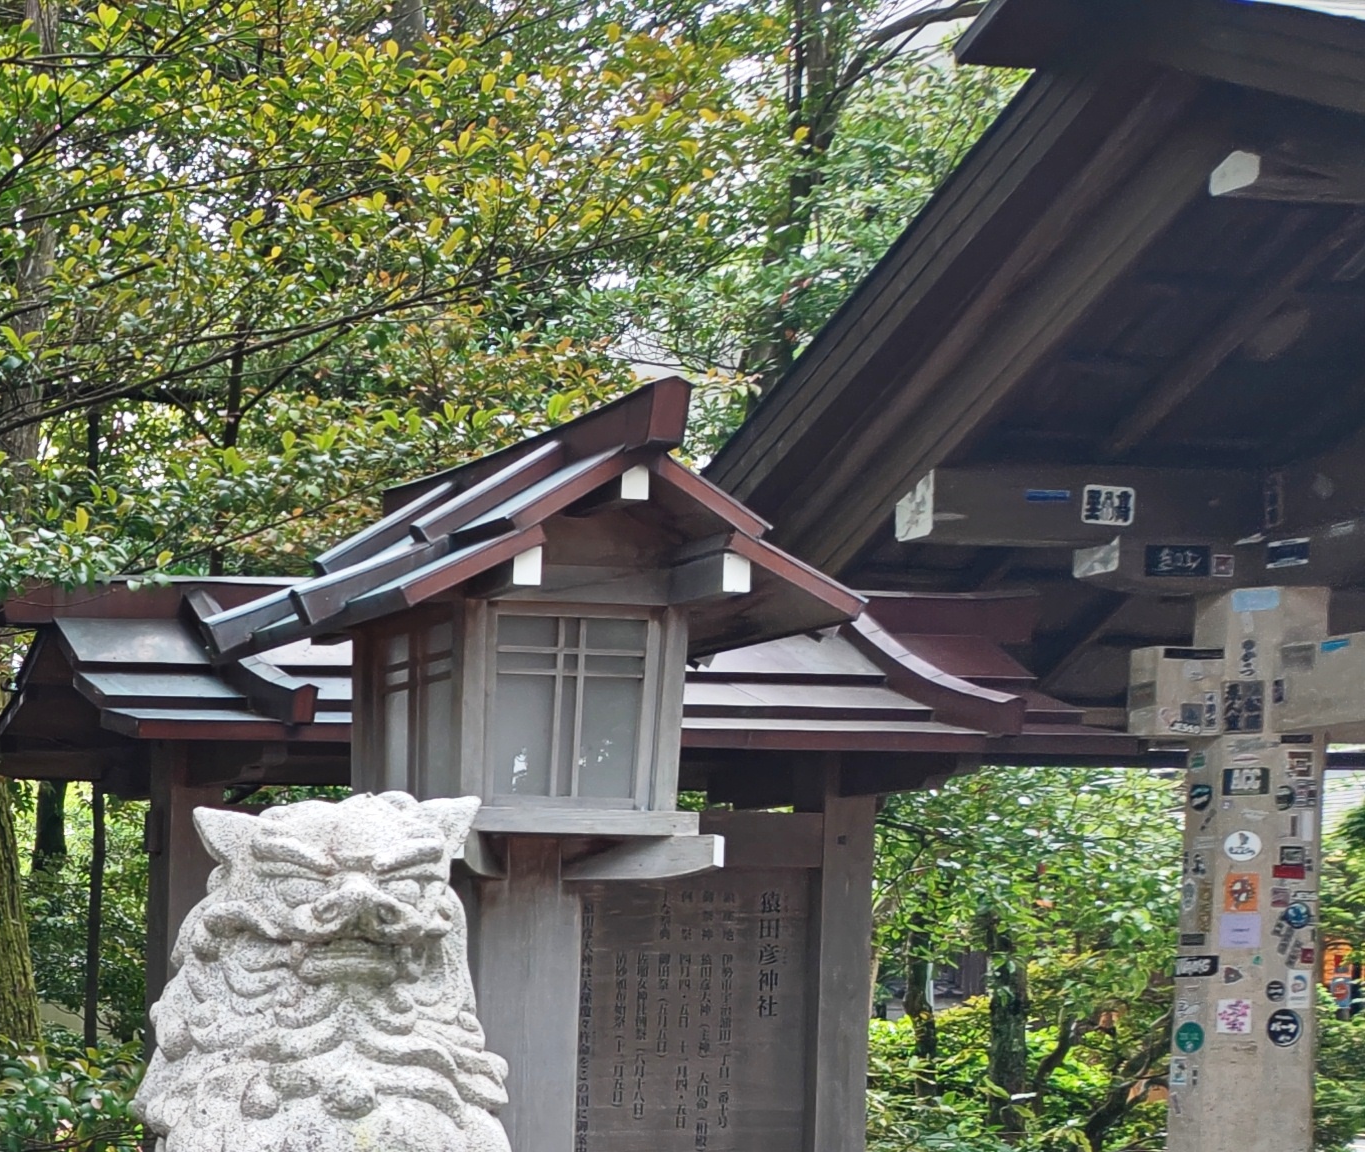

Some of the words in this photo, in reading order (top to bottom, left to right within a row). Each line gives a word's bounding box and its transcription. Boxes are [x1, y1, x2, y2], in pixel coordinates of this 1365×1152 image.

[757, 891, 781, 1018] 猿田彦神社
